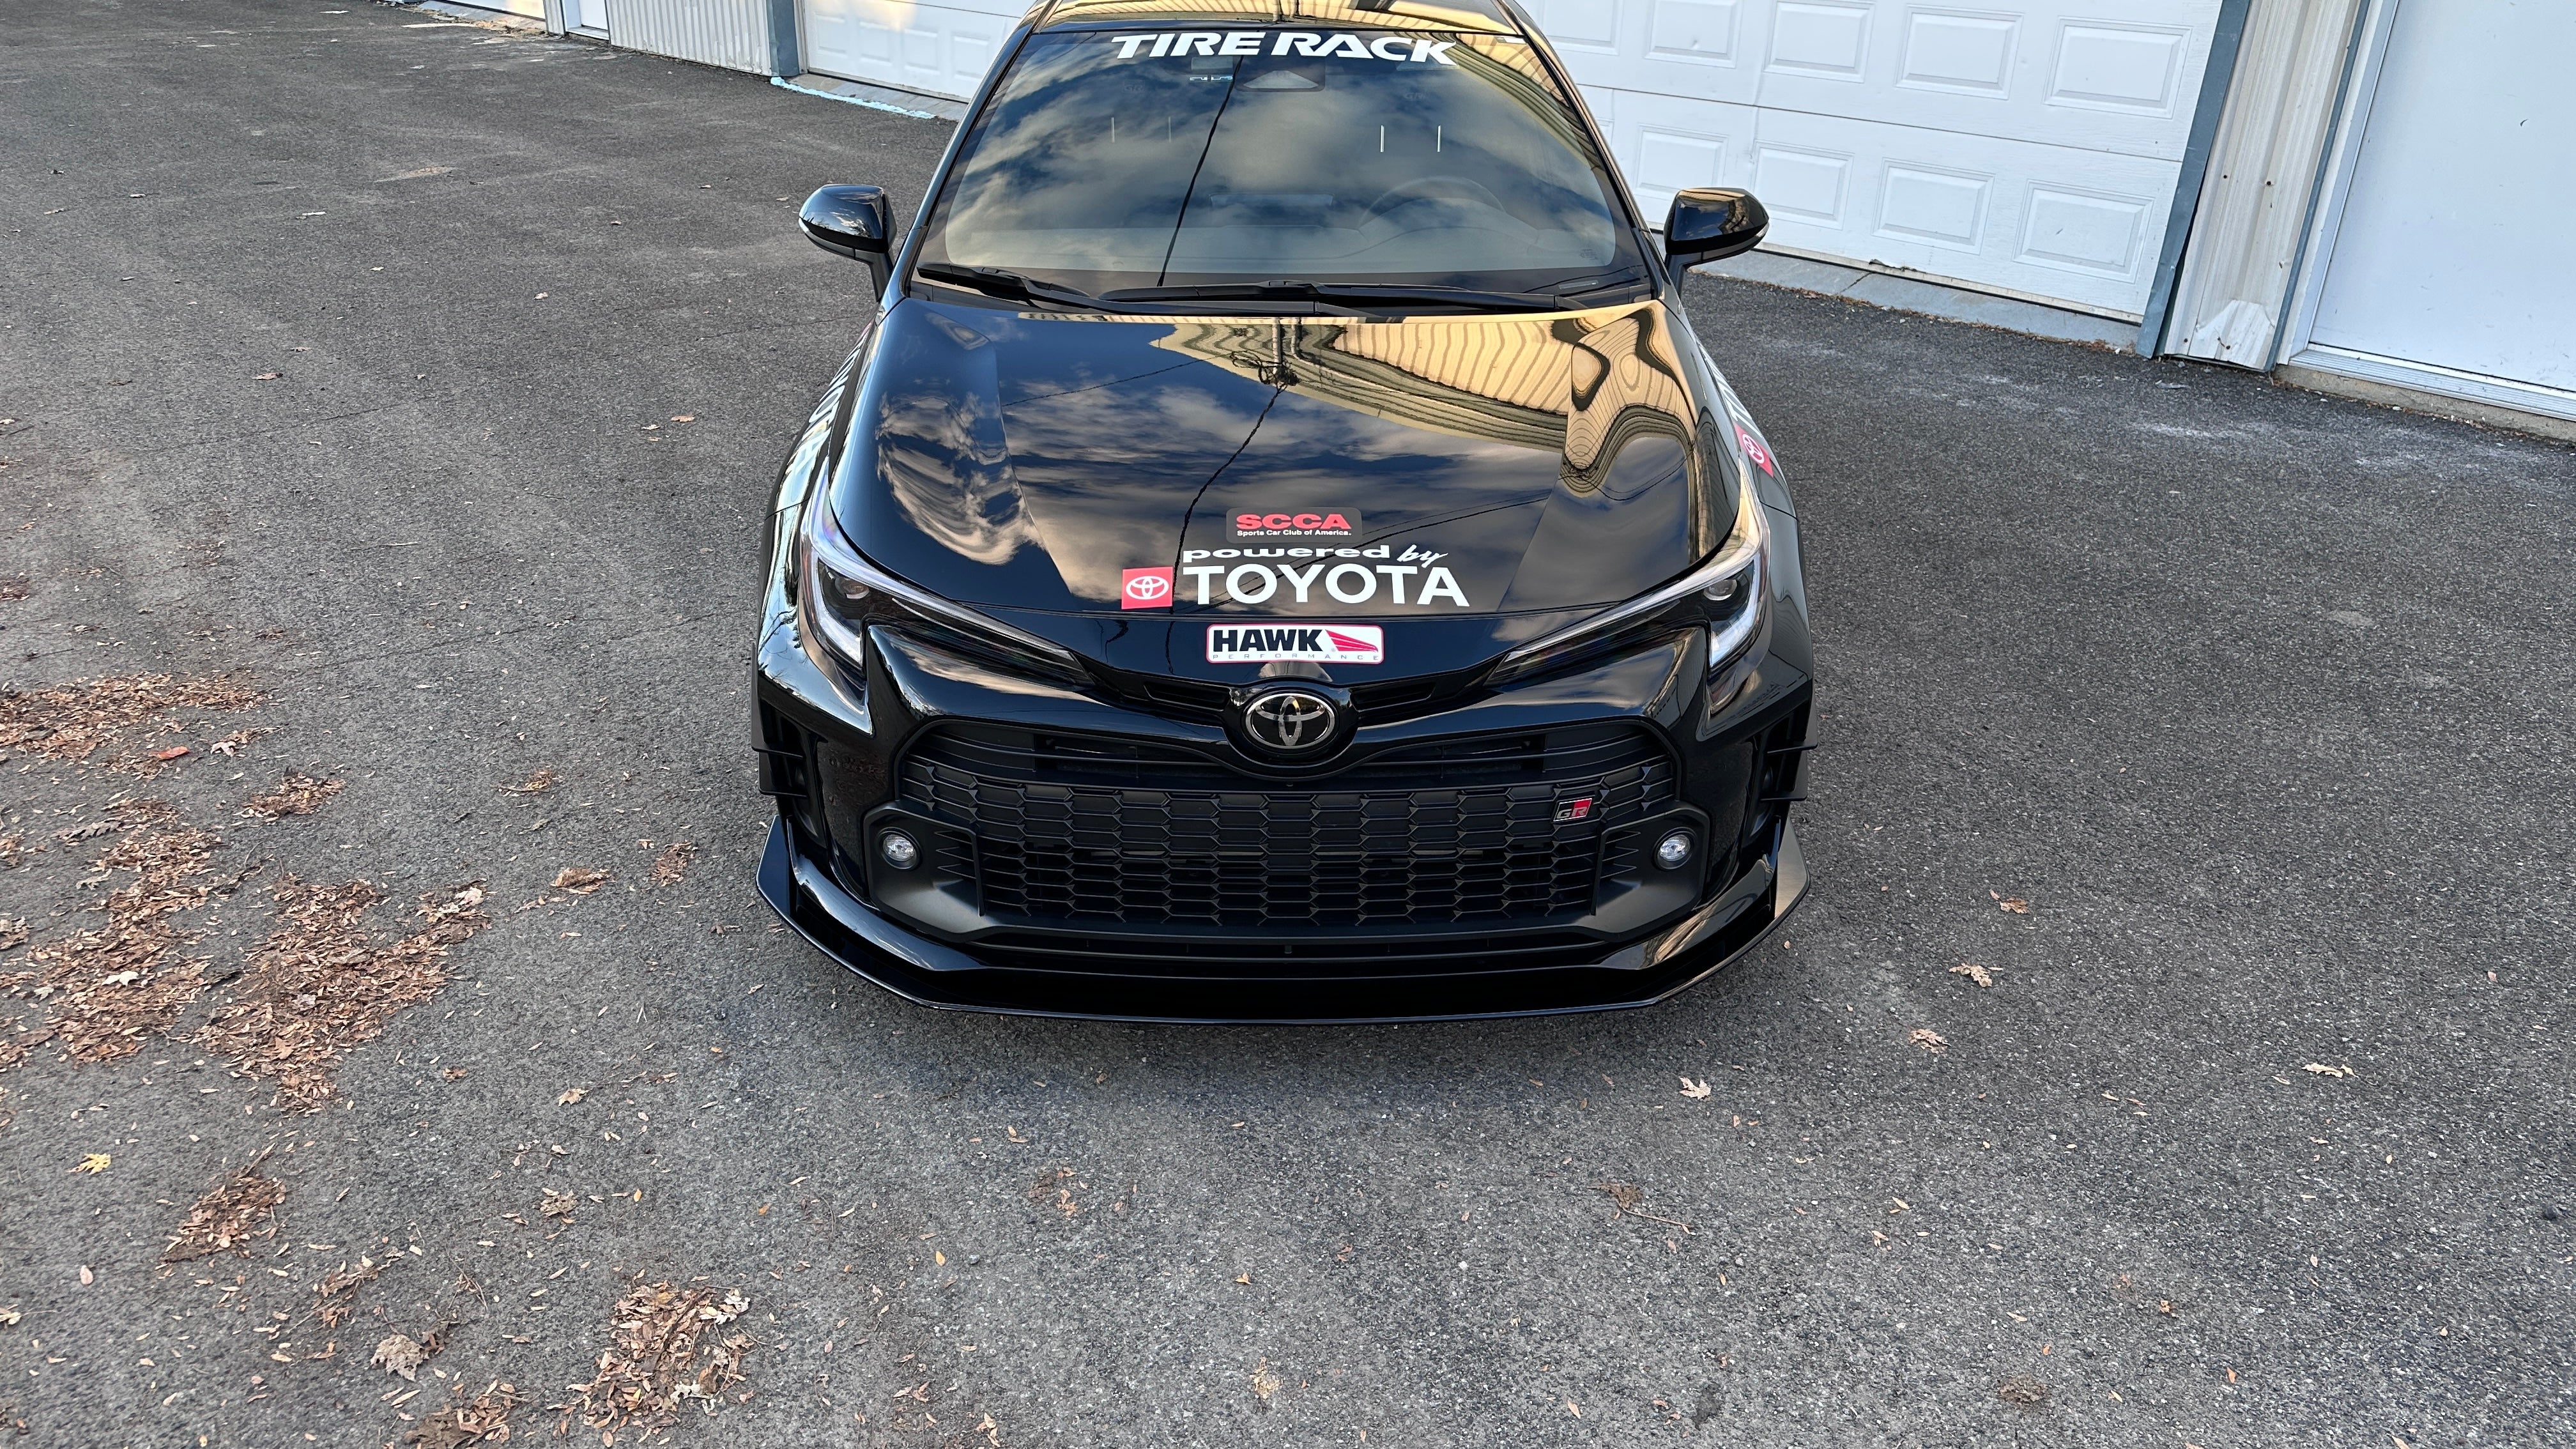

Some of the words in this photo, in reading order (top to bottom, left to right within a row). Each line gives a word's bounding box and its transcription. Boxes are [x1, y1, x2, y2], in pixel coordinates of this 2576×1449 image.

[1111, 32, 1266, 59] TIRE
[1270, 32, 1457, 66] RACK
[1236, 513, 1352, 530] SCCA
[1183, 544, 1390, 563] powered
[1396, 544, 1449, 569] by
[1183, 564, 1470, 607] TOYOTA
[1213, 629, 1324, 652] HAWK
[1556, 806, 1588, 819] GR
